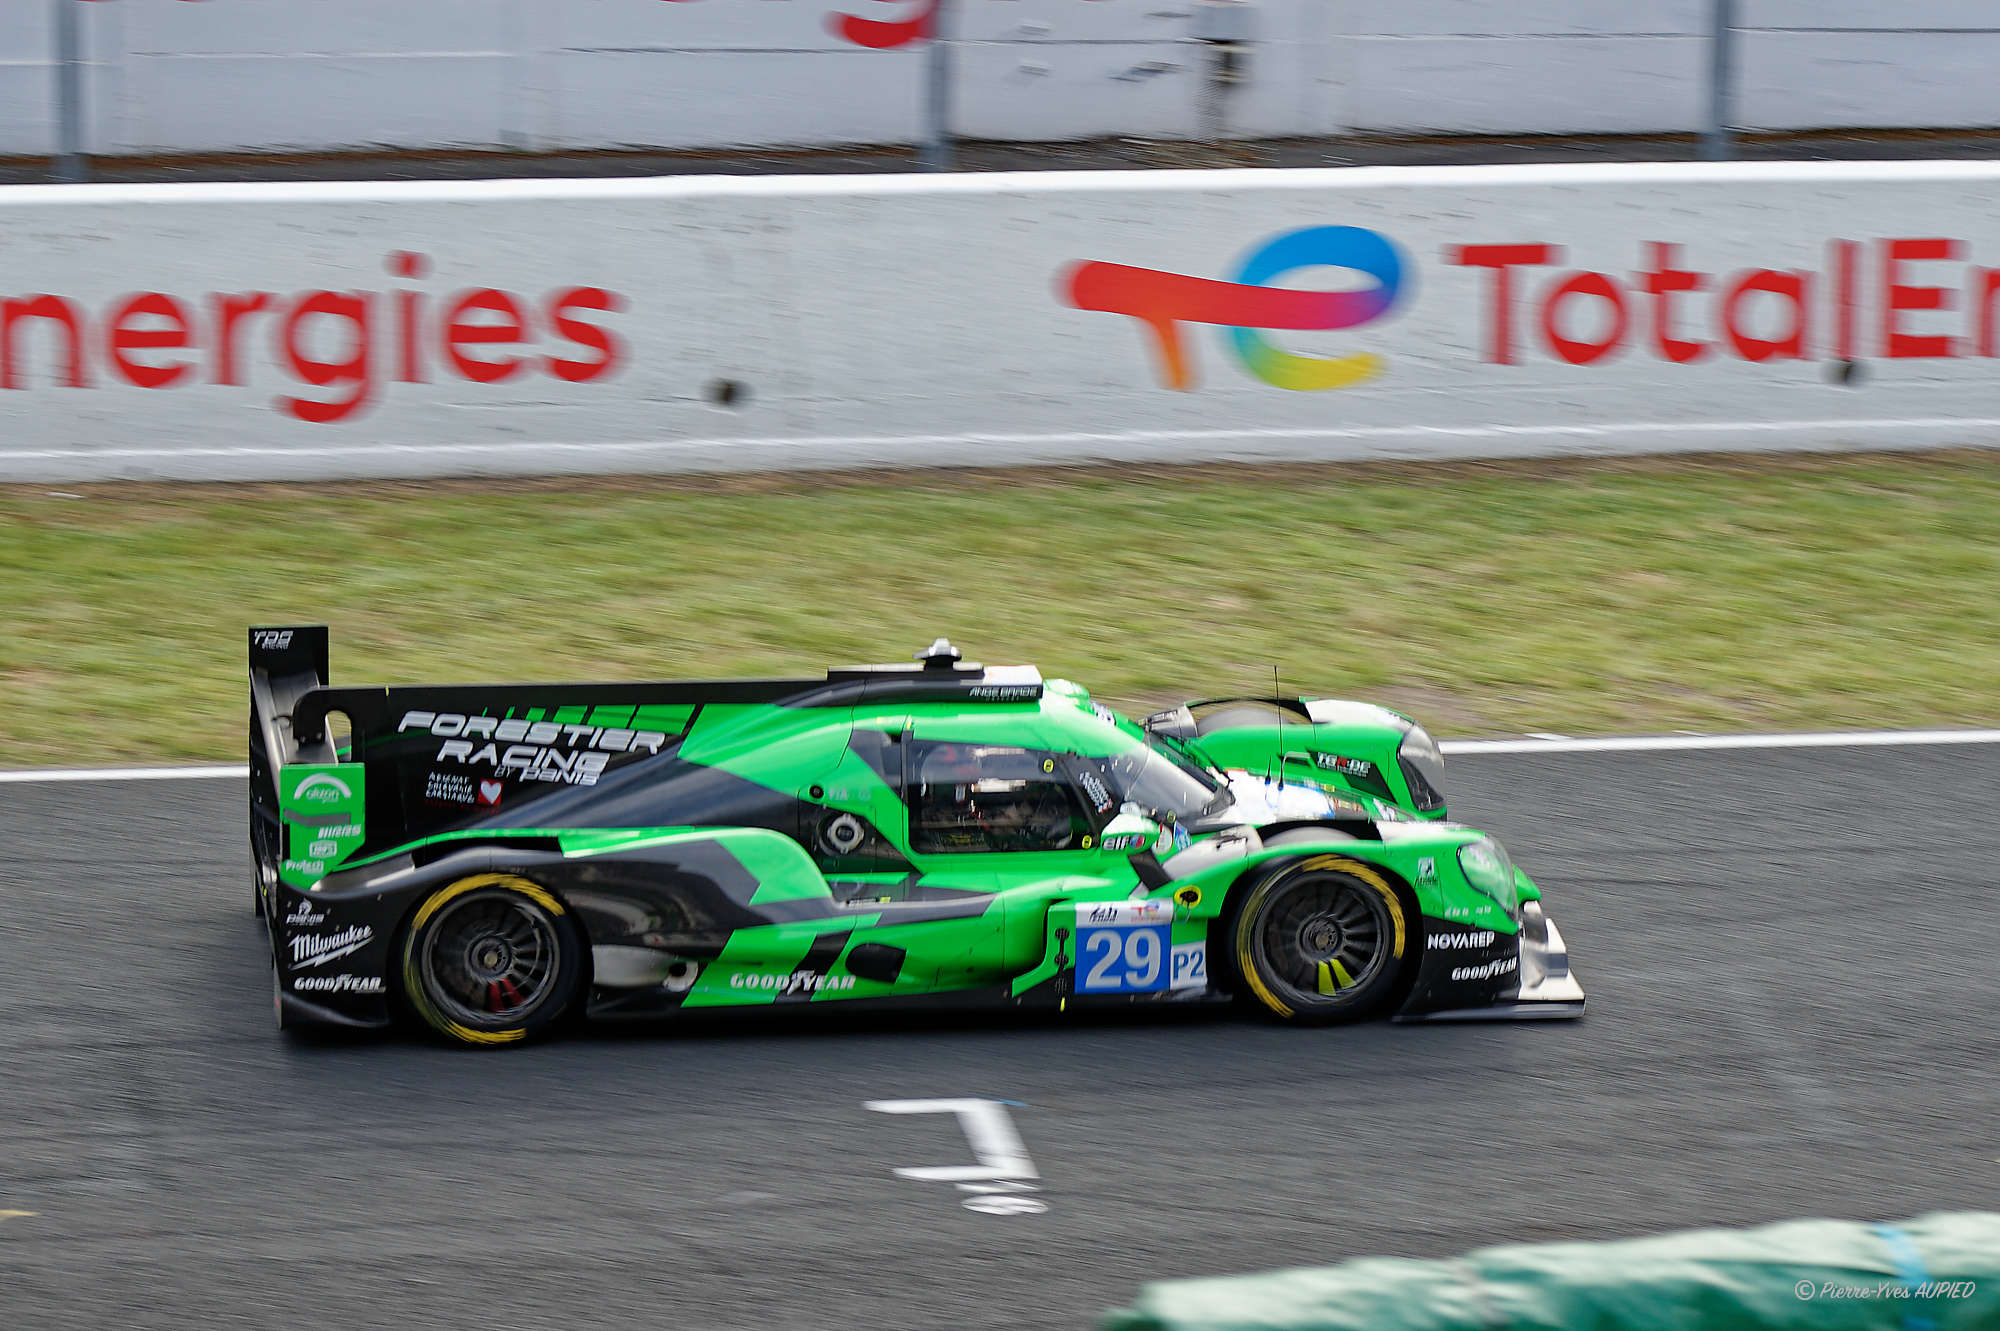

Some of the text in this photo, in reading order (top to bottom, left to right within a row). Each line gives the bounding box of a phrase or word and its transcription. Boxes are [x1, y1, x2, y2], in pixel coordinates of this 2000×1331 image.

[397, 710, 666, 755] FORESTIER
[436, 739, 611, 773] RACING
[288, 924, 373, 962] Milwaukee
[1427, 931, 1495, 950] NOVAREP
[1085, 928, 1162, 988] 29
[1173, 947, 1205, 981] P2
[1451, 956, 1517, 981] GOODYEAR
[294, 974, 381, 993] GOODYEAR
[730, 970, 856, 996] GOODYEAR
